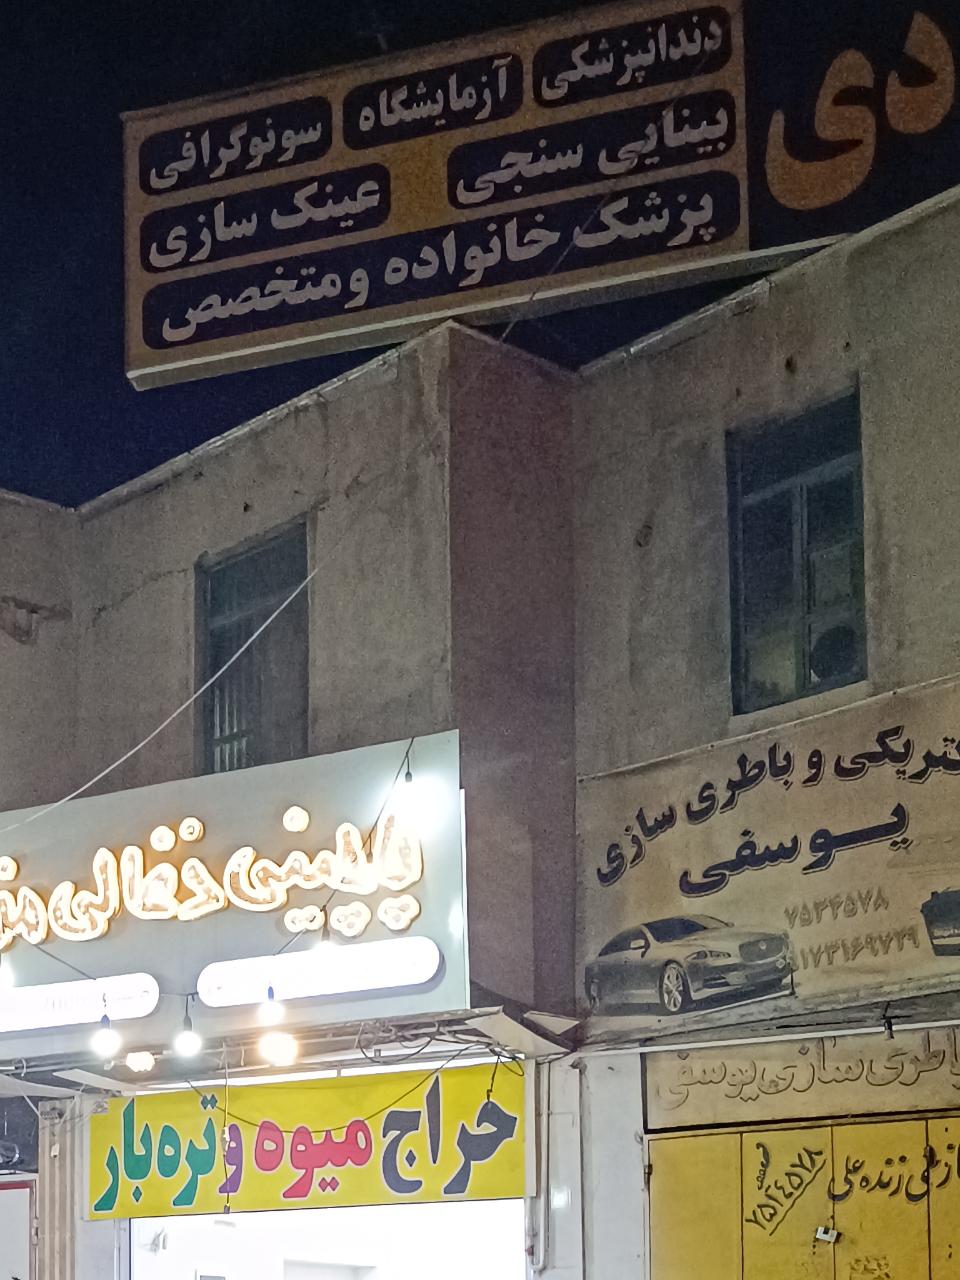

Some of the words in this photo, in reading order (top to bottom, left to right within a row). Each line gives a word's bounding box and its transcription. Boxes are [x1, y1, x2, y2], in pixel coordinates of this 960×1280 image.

[538, 14, 725, 102] دندانپزشکی
[357, 56, 514, 136] آزمایشگاه
[147, 113, 324, 192] سونوگرافی
[600, 97, 731, 176] بینایی
[270, 172, 382, 232] عینک
[454, 142, 585, 206] سنجی
[147, 205, 258, 269] سازی
[382, 216, 564, 290] خانواده
[572, 186, 717, 252] پزشک
[686, 742, 796, 828] باطری
[802, 748, 824, 788] و
[833, 725, 960, 785] تریکی
[596, 802, 678, 889] سازی
[678, 802, 915, 899] یوسفی
[655, 1052, 758, 1111] یوسفی
[757, 1036, 864, 1095] سازی
[218, 1123, 243, 1195] و
[254, 1119, 374, 1200] میوه
[380, 1074, 519, 1195] حراج
